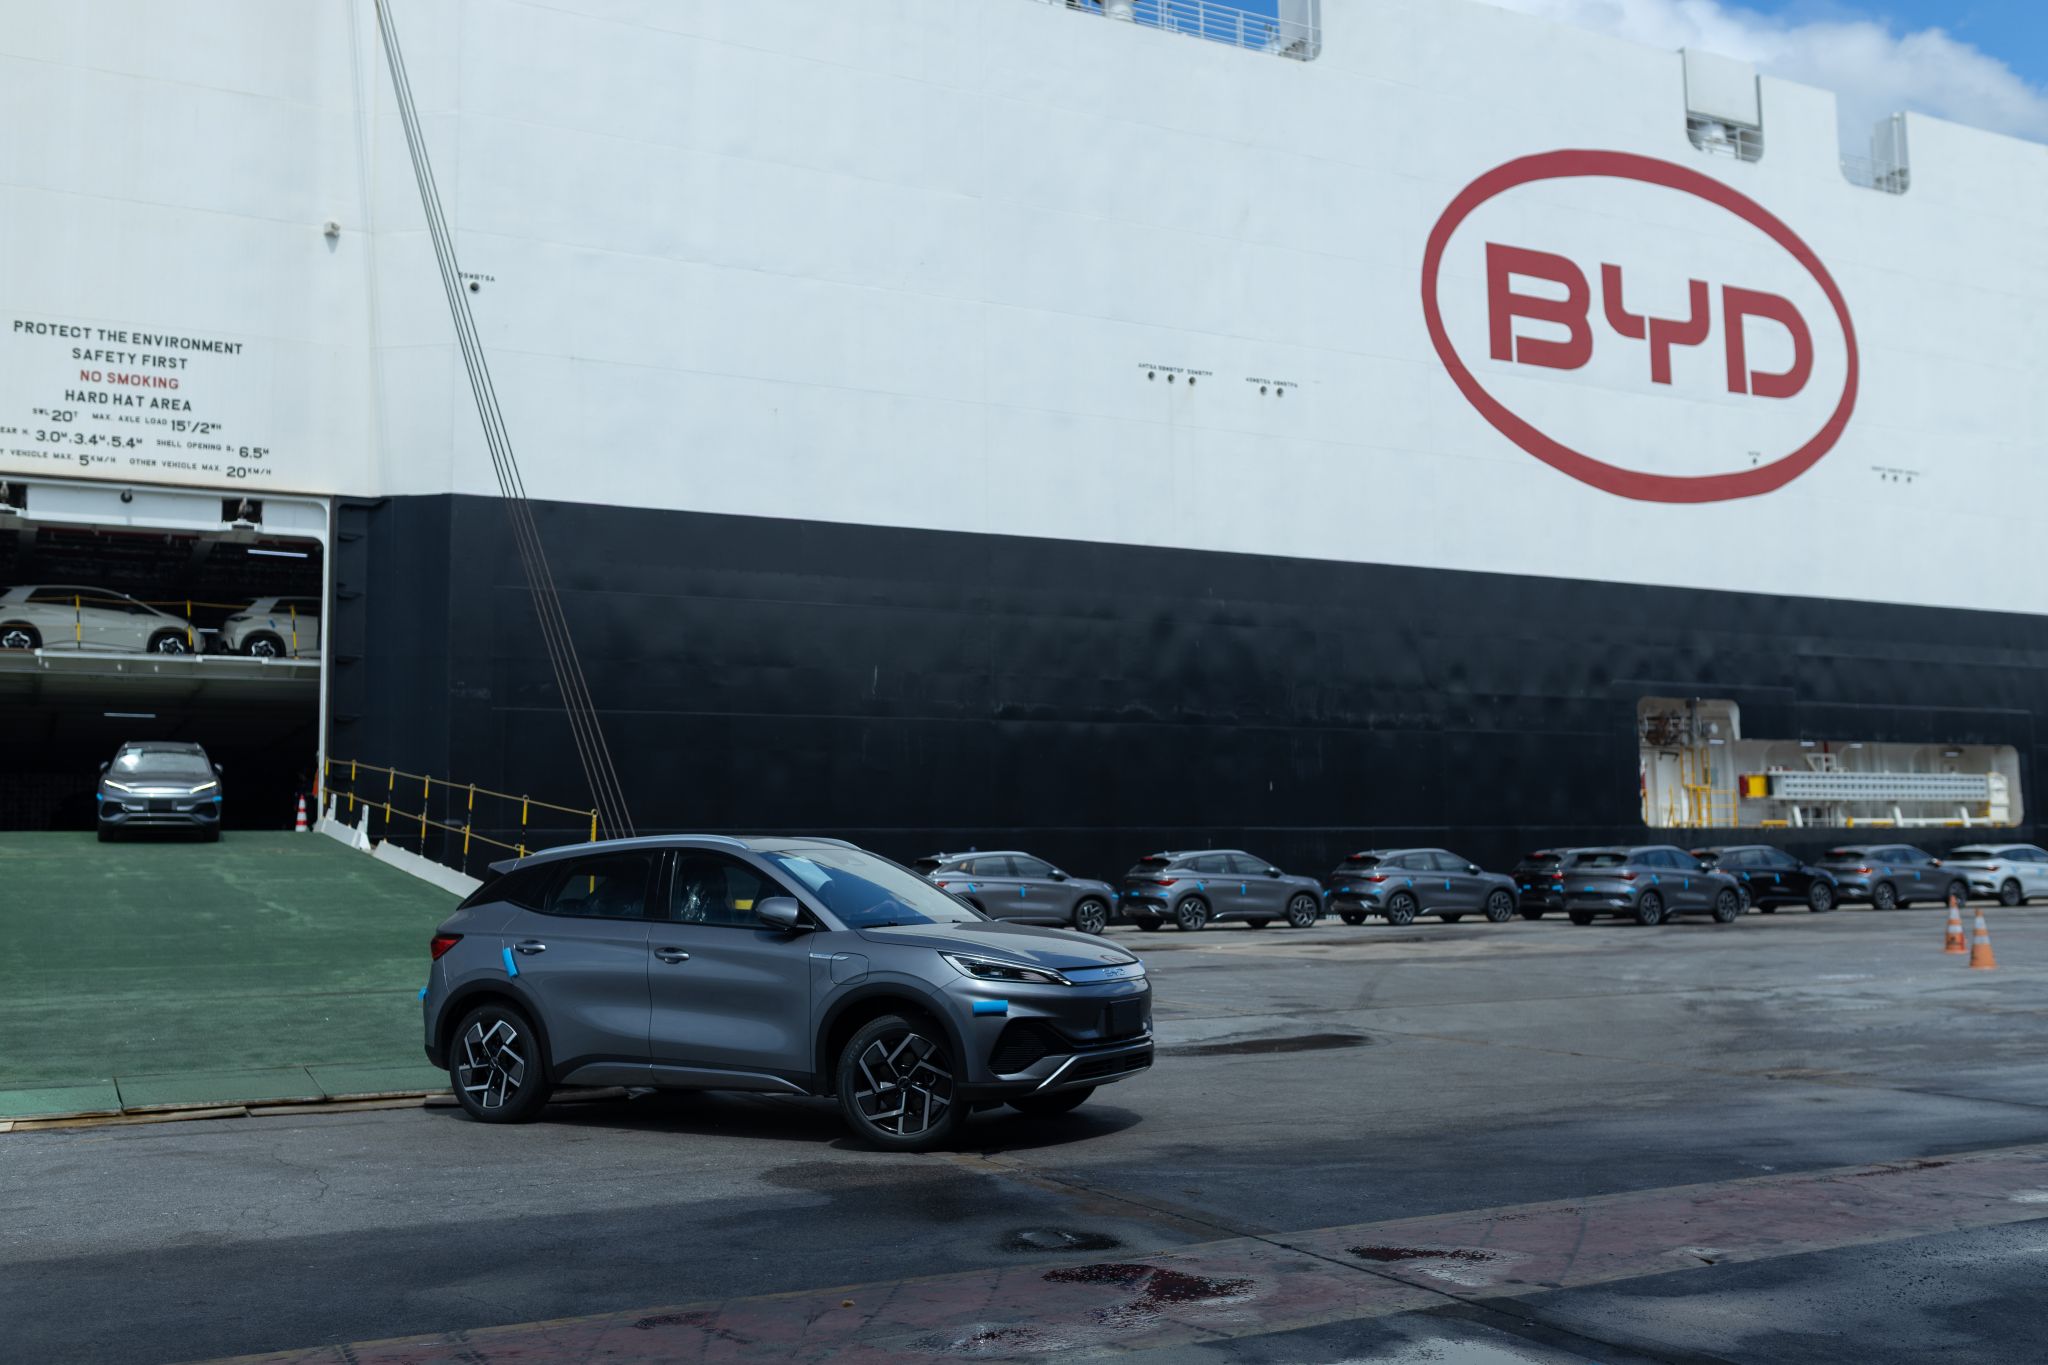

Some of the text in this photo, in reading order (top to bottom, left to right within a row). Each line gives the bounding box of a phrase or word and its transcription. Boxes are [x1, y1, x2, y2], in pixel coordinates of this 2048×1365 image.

[1485, 242, 1814, 399] BYD
[13, 320, 243, 355] PROTECT THE ENVIRONMENT
[72, 347, 188, 370] SAFETY FIRST
[80, 369, 179, 390] NO SMOKING
[65, 389, 192, 412] HARD HAT AREA
[118, 415, 141, 424] AXLE
[145, 417, 168, 426] LOAD
[156, 439, 182, 449] SHELL
[187, 441, 222, 451] OPENING
[10, 448, 48, 459] VEHICLE
[129, 457, 157, 467] OTHER
[162, 460, 197, 471] VEHICLE
